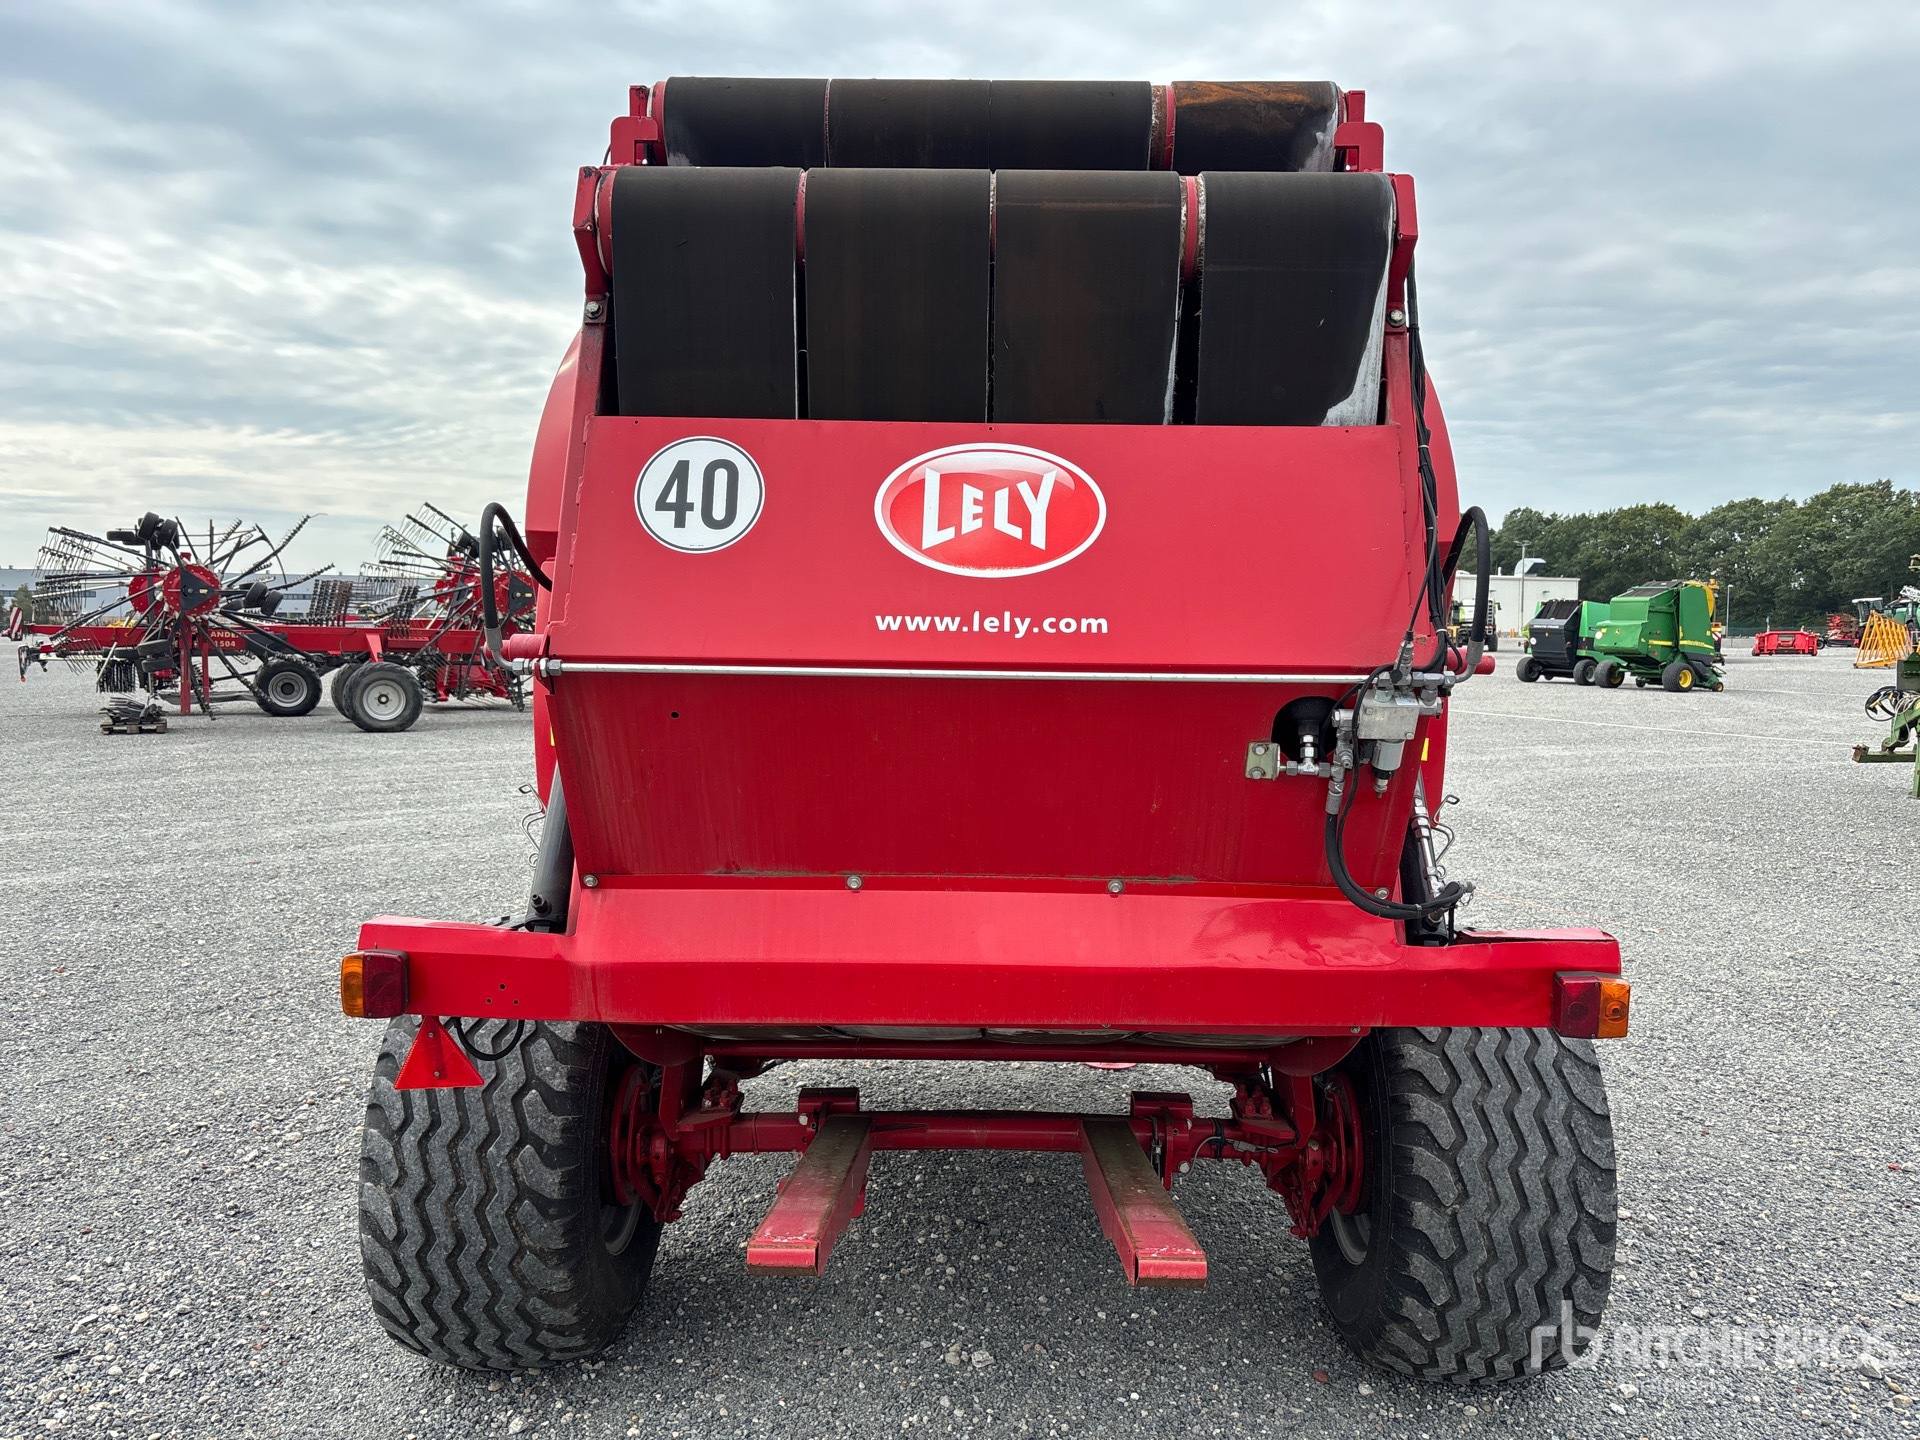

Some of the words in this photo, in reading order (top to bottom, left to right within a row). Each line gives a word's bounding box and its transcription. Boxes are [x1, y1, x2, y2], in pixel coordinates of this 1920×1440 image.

[654, 458, 740, 531] 40
[921, 466, 1058, 551] LELY
[214, 640, 236, 648] 1504
[874, 610, 1109, 639] www.lely.com
